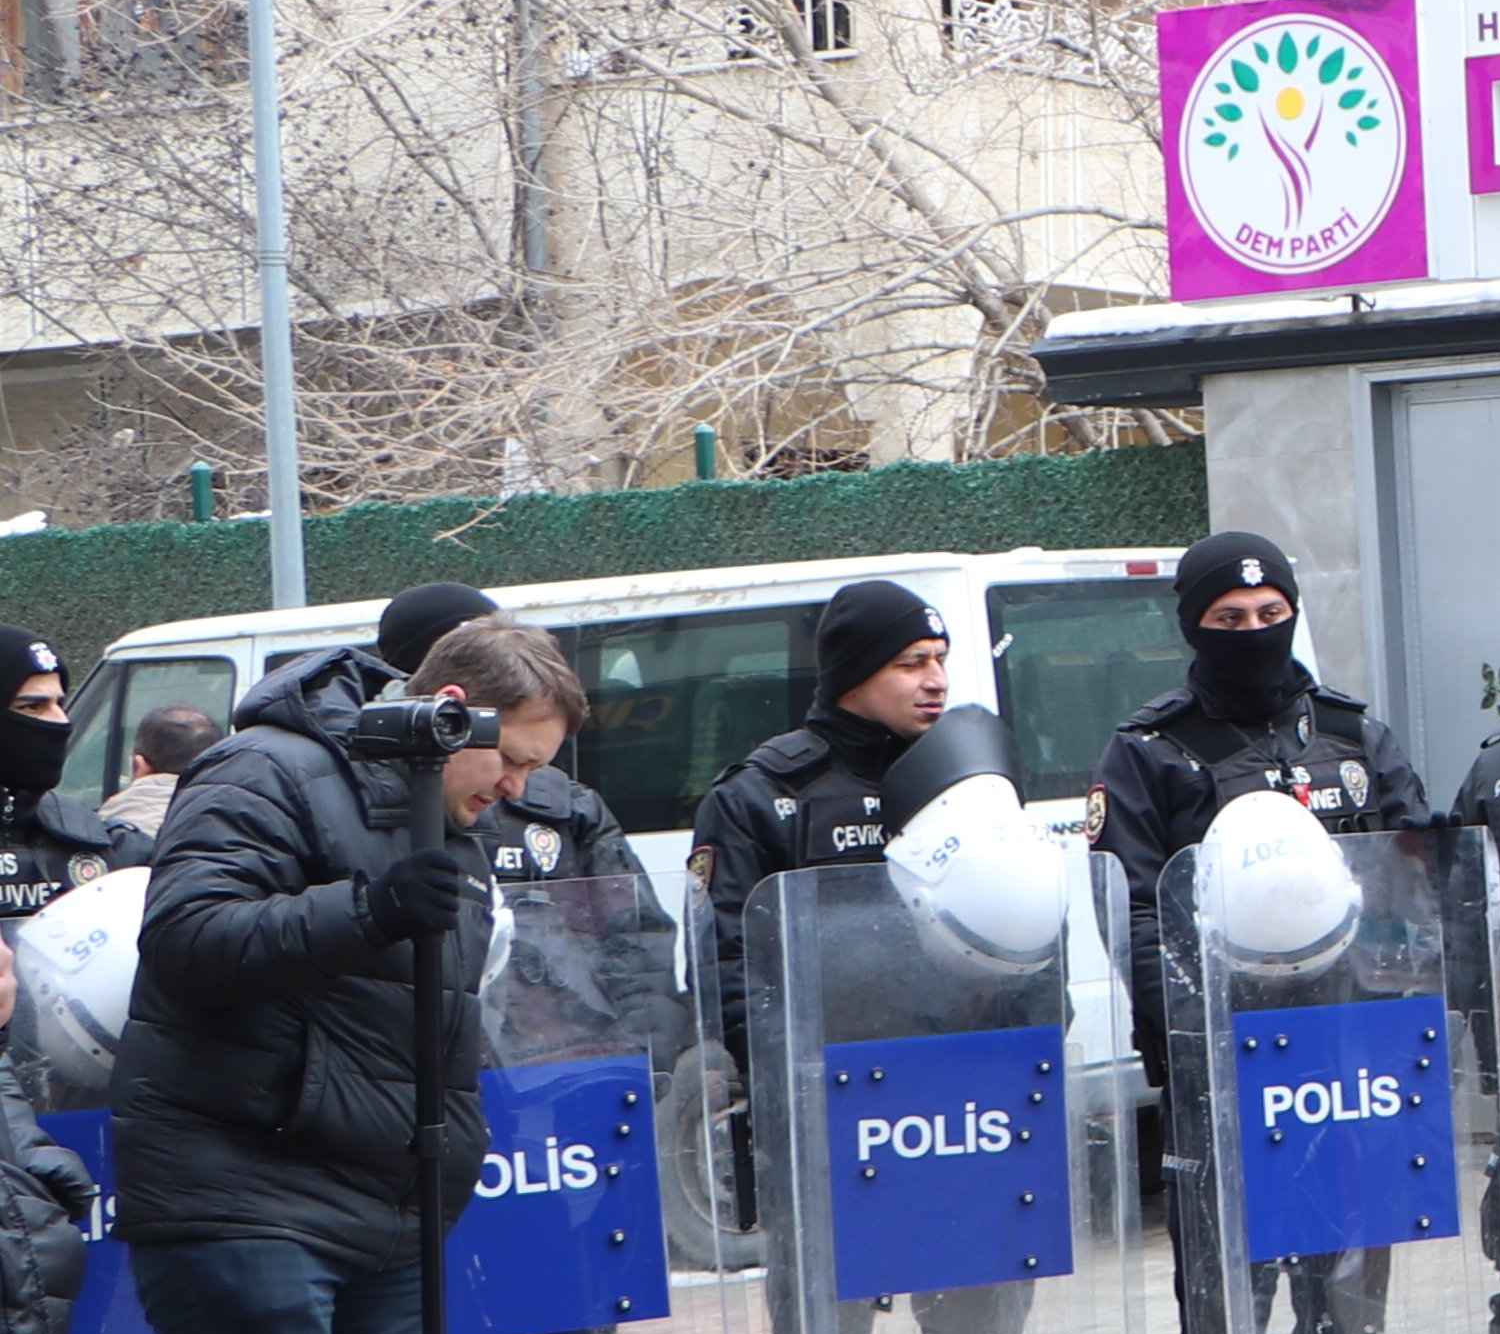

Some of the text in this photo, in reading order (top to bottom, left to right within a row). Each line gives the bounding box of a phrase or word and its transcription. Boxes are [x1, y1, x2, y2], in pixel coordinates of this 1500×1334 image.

[1235, 206, 1359, 259] DEM PARTİ
[832, 823, 886, 851] ÇEVİK
[1263, 1067, 1402, 1127] POLİS
[858, 1101, 1012, 1161] POLİS
[475, 1136, 599, 1199] OLİS
